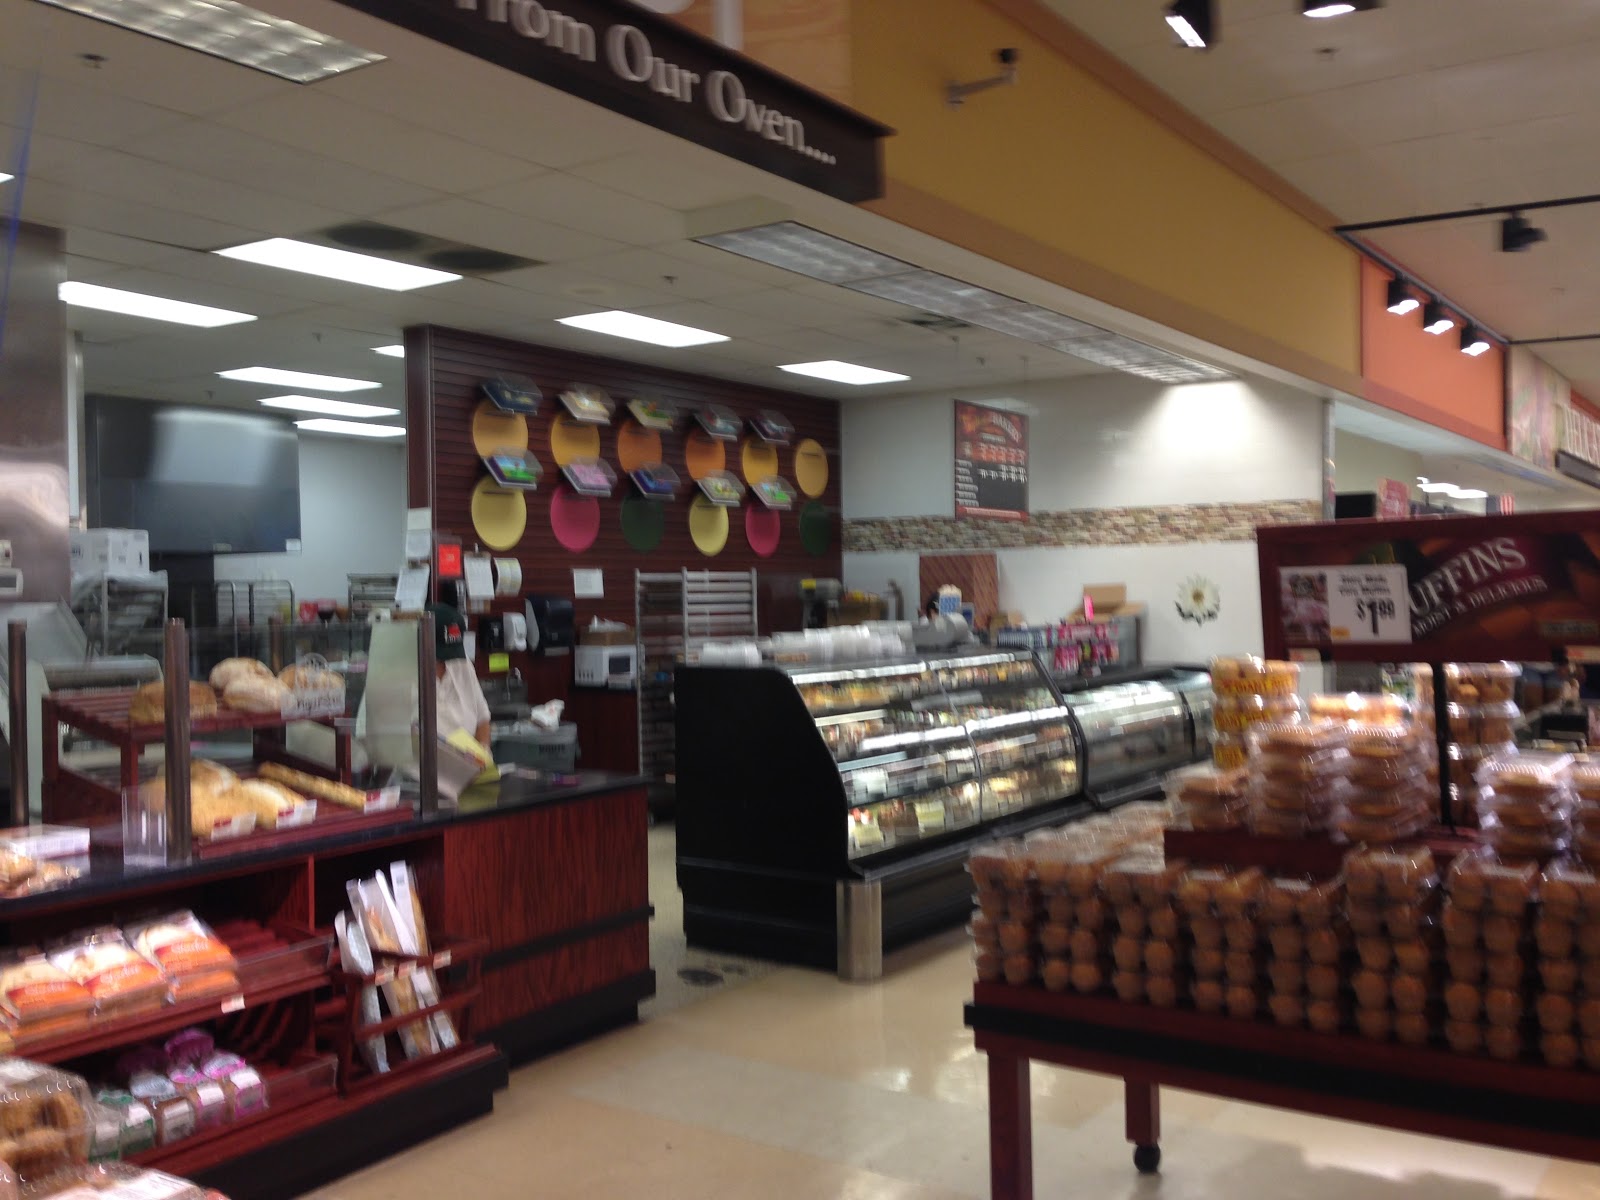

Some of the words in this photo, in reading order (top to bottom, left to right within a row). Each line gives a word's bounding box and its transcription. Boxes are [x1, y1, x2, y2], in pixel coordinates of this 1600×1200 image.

[455, 0, 596, 62] rom
[605, 24, 700, 103] Our
[1408, 537, 1526, 617] UFFINS
